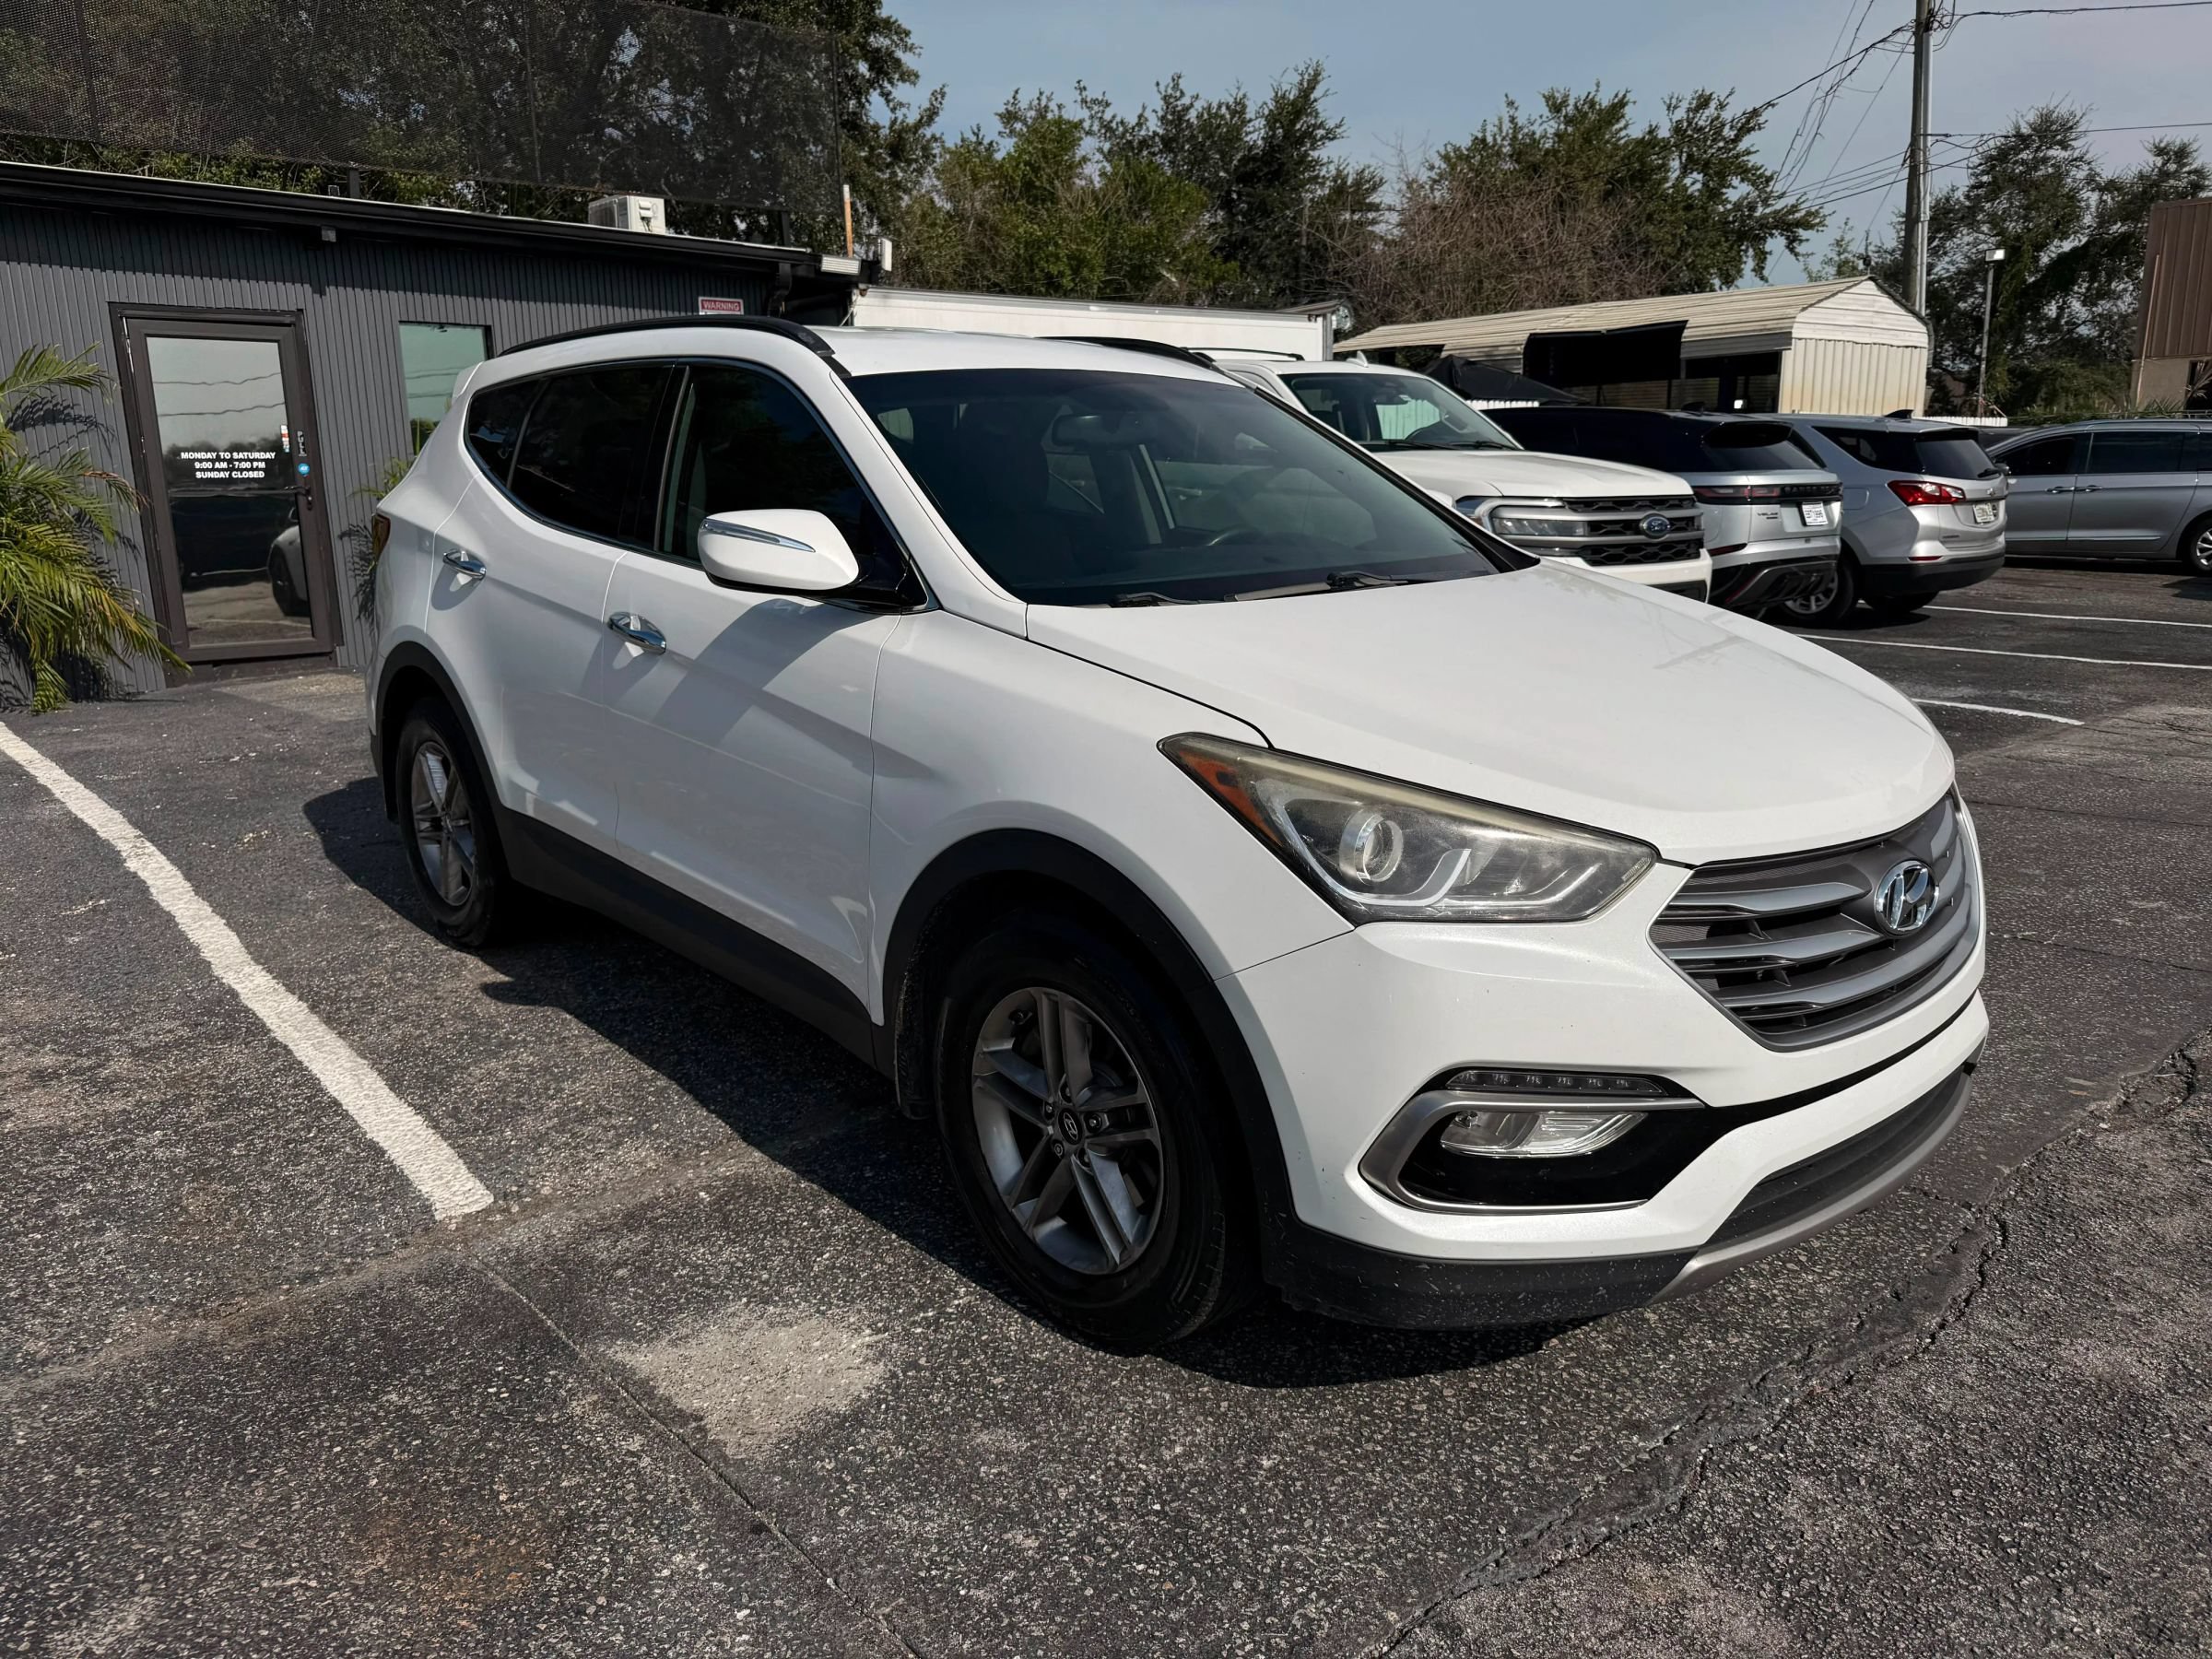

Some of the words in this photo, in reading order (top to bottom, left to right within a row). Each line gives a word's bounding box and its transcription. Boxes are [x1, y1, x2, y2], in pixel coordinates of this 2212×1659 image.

[702, 301, 739, 311] WARNING
[181, 452, 217, 460] MONDAY
[220, 452, 230, 460] TO
[232, 452, 276, 460] SATURDAY
